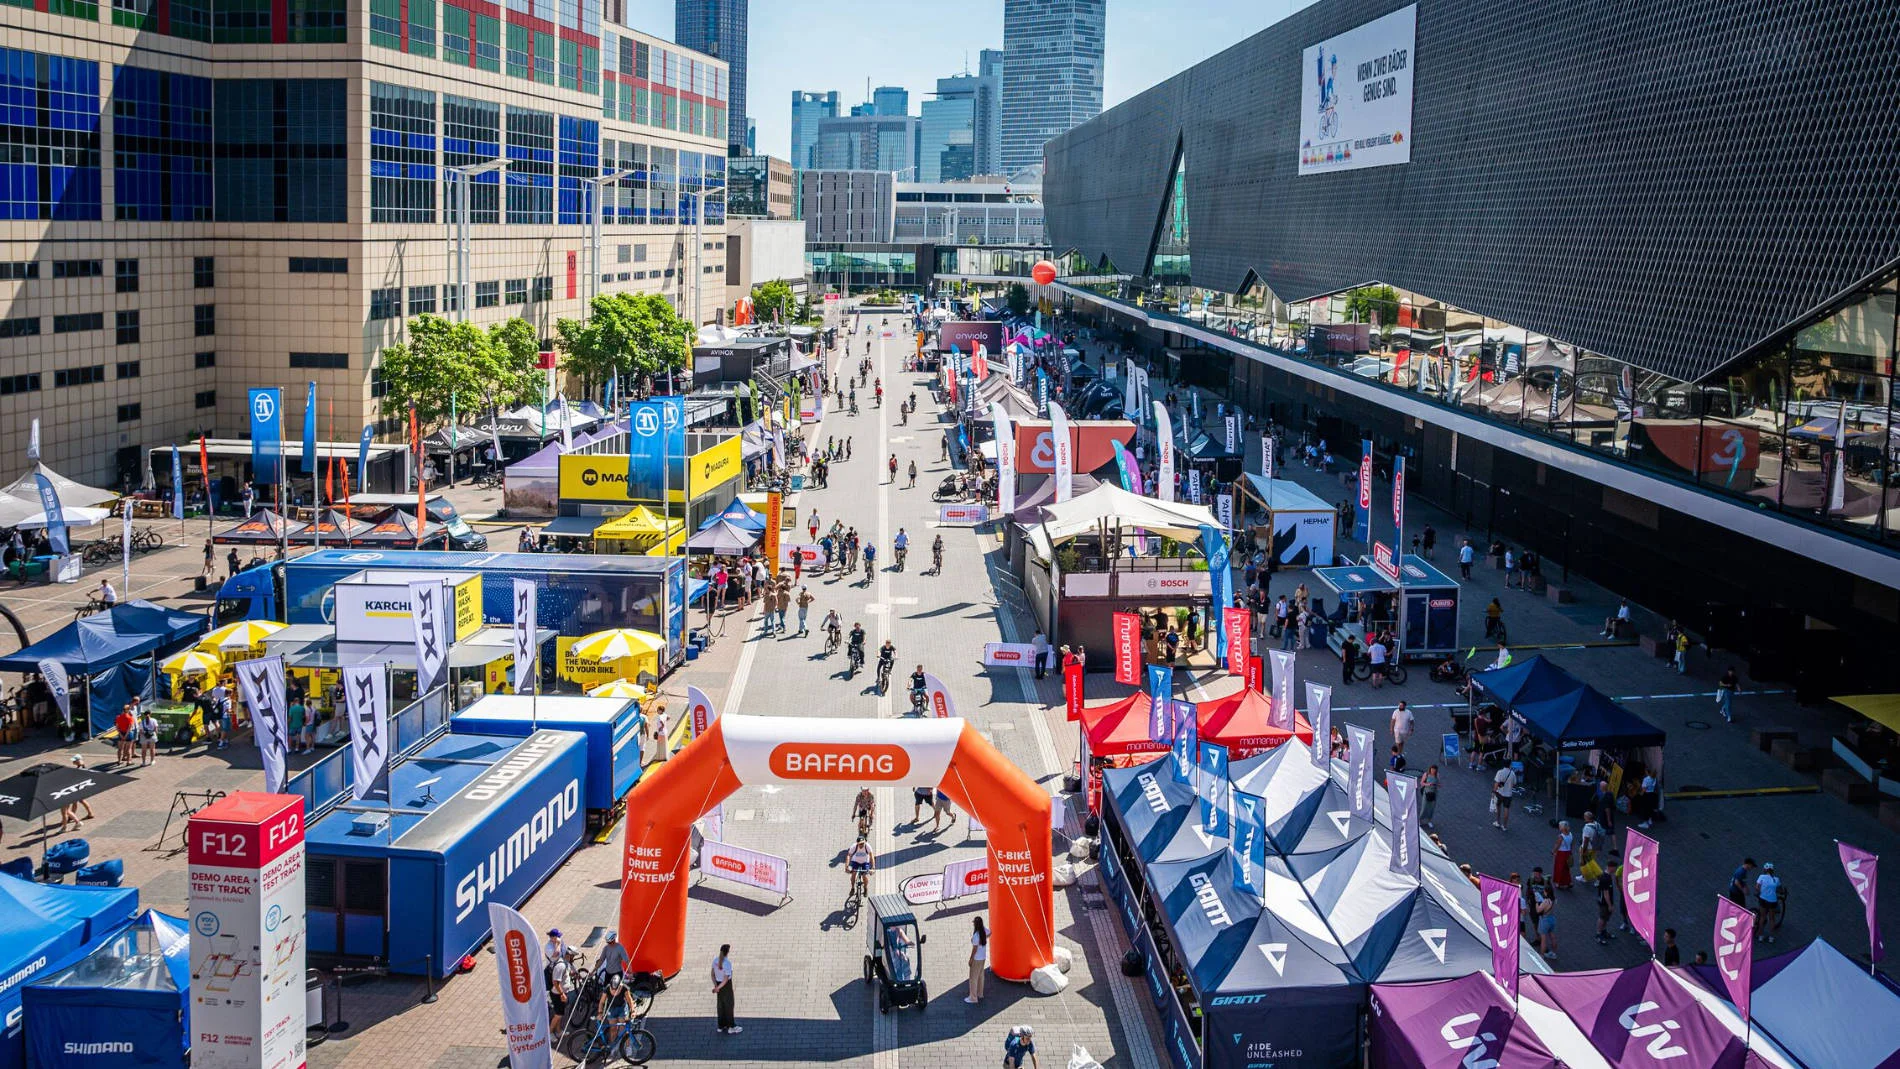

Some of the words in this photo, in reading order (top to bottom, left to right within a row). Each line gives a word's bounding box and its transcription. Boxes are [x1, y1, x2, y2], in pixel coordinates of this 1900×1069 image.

[1357, 61, 1373, 83] WENN
[1373, 55, 1387, 78] ZWEI
[1388, 48, 1407, 73] RÄDER
[1363, 80, 1382, 103] GENUG
[1383, 76, 1397, 98] SIND.
[567, 255, 576, 272] 10
[955, 331, 989, 341] enviolo
[771, 496, 779, 548] REGISTRATION
[565, 665, 575, 673] TO
[577, 665, 596, 673] YOUR
[597, 666, 616, 674] BIKE.
[464, 735, 565, 800] SHIMANO
[786, 753, 894, 774] BAFANG
[50, 778, 96, 800] XTR
[1137, 772, 1173, 813] GIANT
[269, 814, 299, 850] F12
[202, 832, 247, 856] F12
[456, 778, 578, 925] SHIMANO
[629, 844, 662, 857] E-BIKE
[997, 850, 1031, 861] E-BIKE
[628, 858, 659, 870] DRIVE
[997, 863, 1030, 873] DRIVE
[192, 872, 220, 881] DEMO
[224, 874, 249, 884] AREA
[263, 865, 282, 882] DEMO
[263, 877, 278, 892] TEST
[280, 862, 301, 880] TRACK
[627, 870, 675, 883] SYSTEMS
[997, 872, 1045, 885] SYSTEMS
[192, 882, 215, 892] TEST
[218, 884, 251, 895] TRACK
[909, 880, 928, 889] SLOW
[1189, 871, 1234, 927] GIANT
[509, 938, 527, 995] BAFANG
[0, 955, 47, 994] SHIMANO
[1211, 994, 1267, 1006] GIANT
[1619, 1000, 1688, 1060] Liv
[201, 1033, 219, 1043] F12
[510, 1033, 533, 1043] Drive
[64, 1042, 134, 1055] SHIMANO
[1247, 1042, 1272, 1050] RIDE
[1246, 1049, 1303, 1059] UNLEASHED
